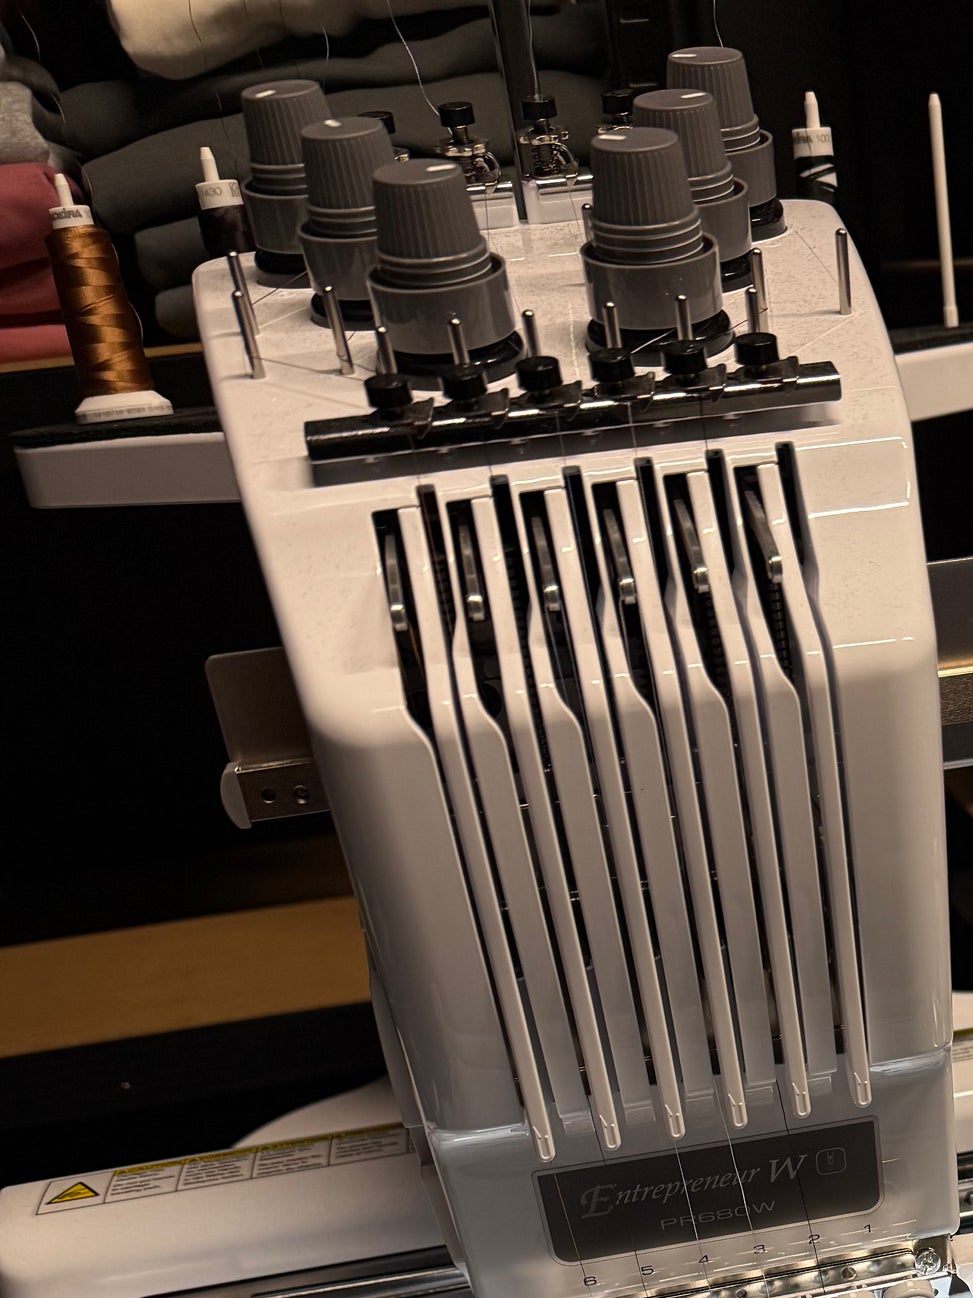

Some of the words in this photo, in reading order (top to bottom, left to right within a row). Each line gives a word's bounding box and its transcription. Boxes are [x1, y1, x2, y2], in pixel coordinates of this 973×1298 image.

[580, 1167, 761, 1220] Entrepreneur
[768, 1153, 808, 1184] W
[660, 1200, 776, 1231] PR680W
[583, 1275, 598, 1287] 6
[640, 1264, 654, 1276] 5
[697, 1254, 710, 1264] 4
[753, 1244, 766, 1255] 3
[808, 1233, 821, 1245] 2
[863, 1223, 873, 1234] 1
